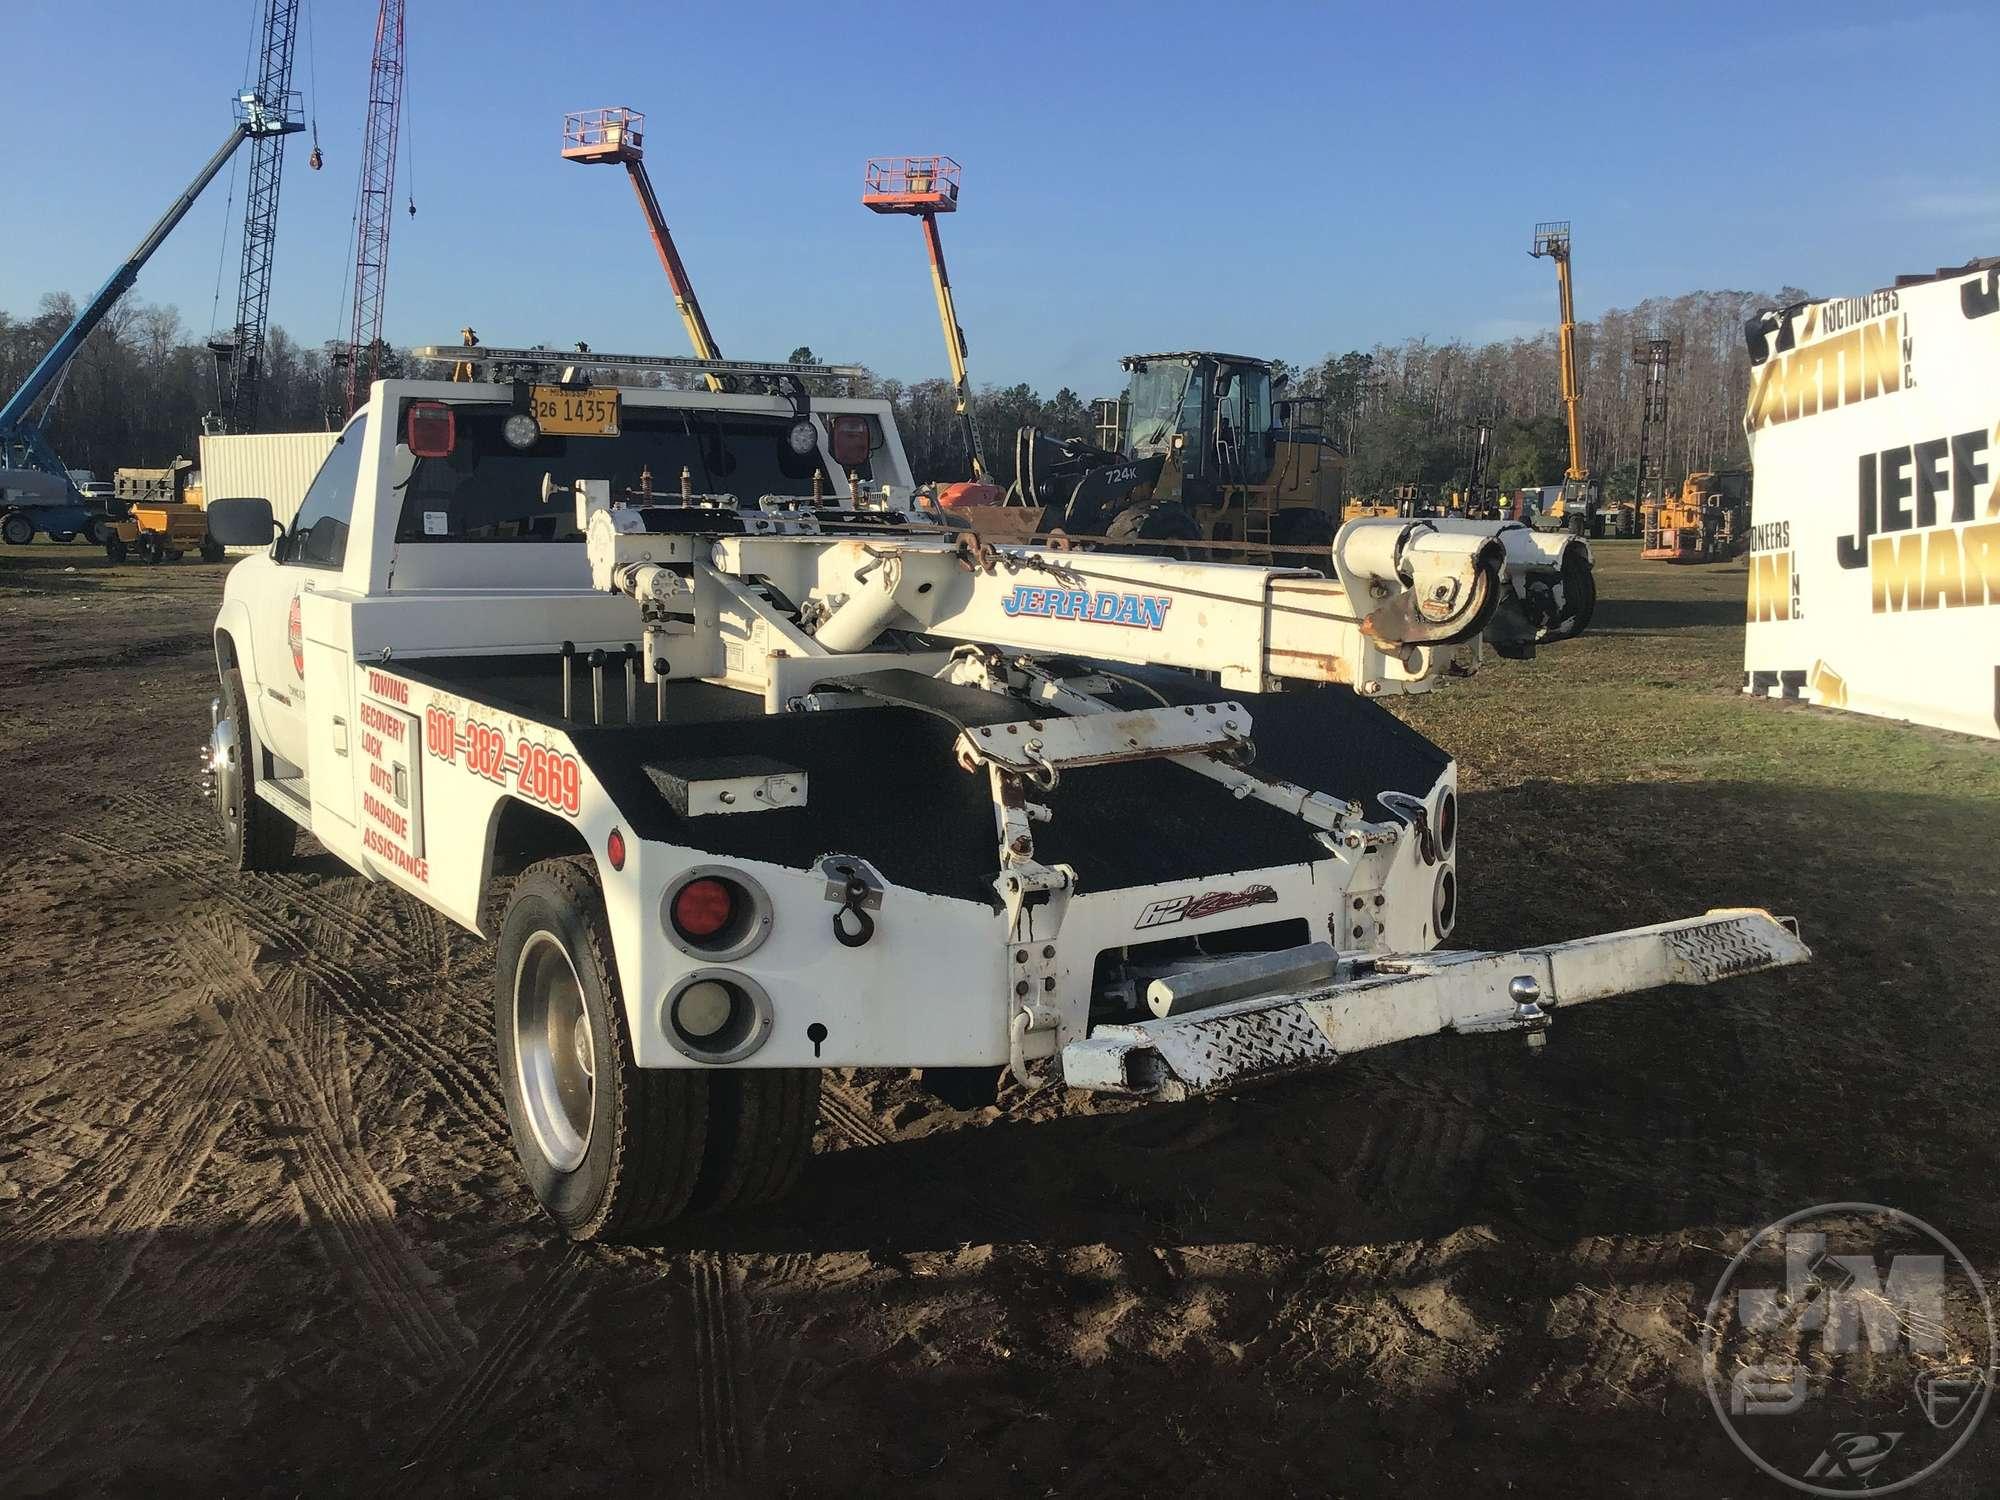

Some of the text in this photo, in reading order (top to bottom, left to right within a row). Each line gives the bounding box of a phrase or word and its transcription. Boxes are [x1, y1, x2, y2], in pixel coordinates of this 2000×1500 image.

[1747, 316, 1900, 433] ARTIN
[563, 399, 616, 423] 14357
[1105, 465, 1137, 485] 724K
[1837, 428, 1989, 570] JEFF
[368, 670, 409, 704] TOWING
[360, 702, 406, 743] RECOVERY
[361, 729, 383, 761] LOCK
[425, 703, 582, 819] 601-382-2669
[370, 763, 392, 795] OUTS
[363, 791, 408, 840] ROADSIDE
[363, 826, 429, 884] ASSISTANCE
